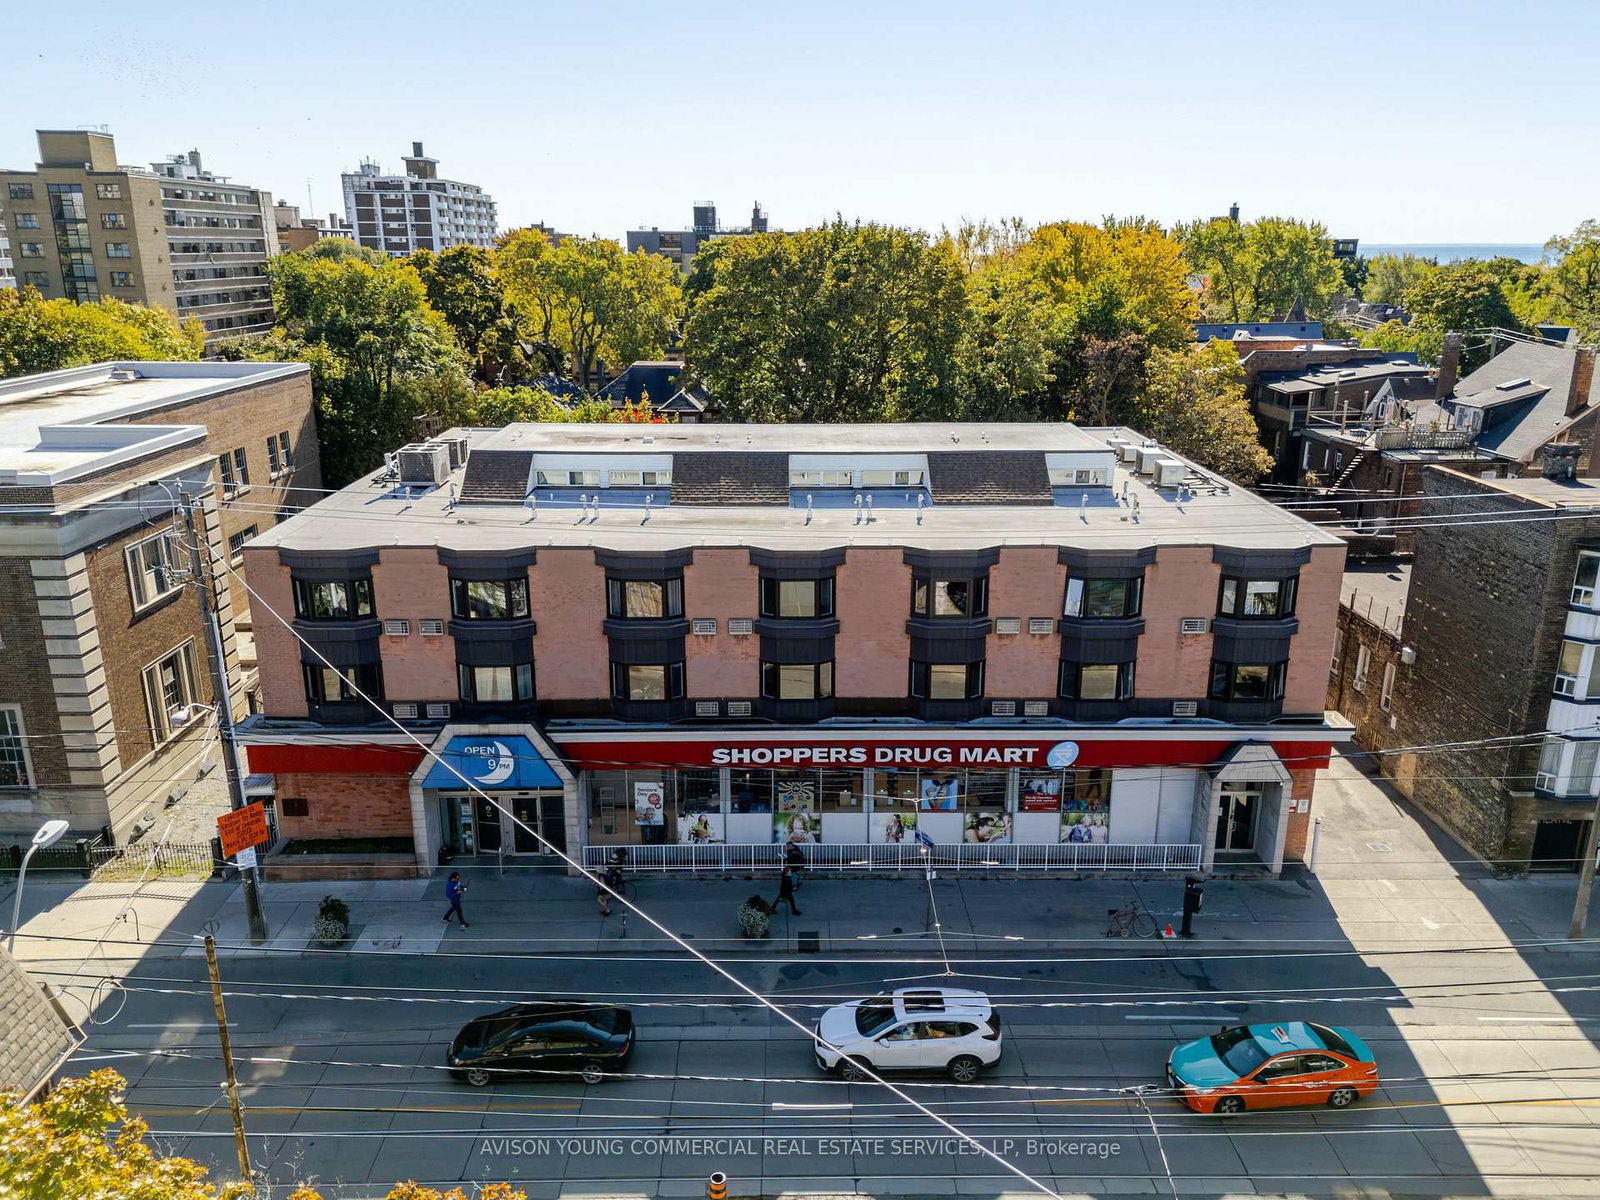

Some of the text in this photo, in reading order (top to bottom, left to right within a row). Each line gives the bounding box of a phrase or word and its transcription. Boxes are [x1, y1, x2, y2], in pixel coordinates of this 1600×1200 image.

[464, 746, 495, 754] OPEN
[711, 748, 1039, 764] SHOPPERS DRUG MART
[488, 759, 496, 770] 9
